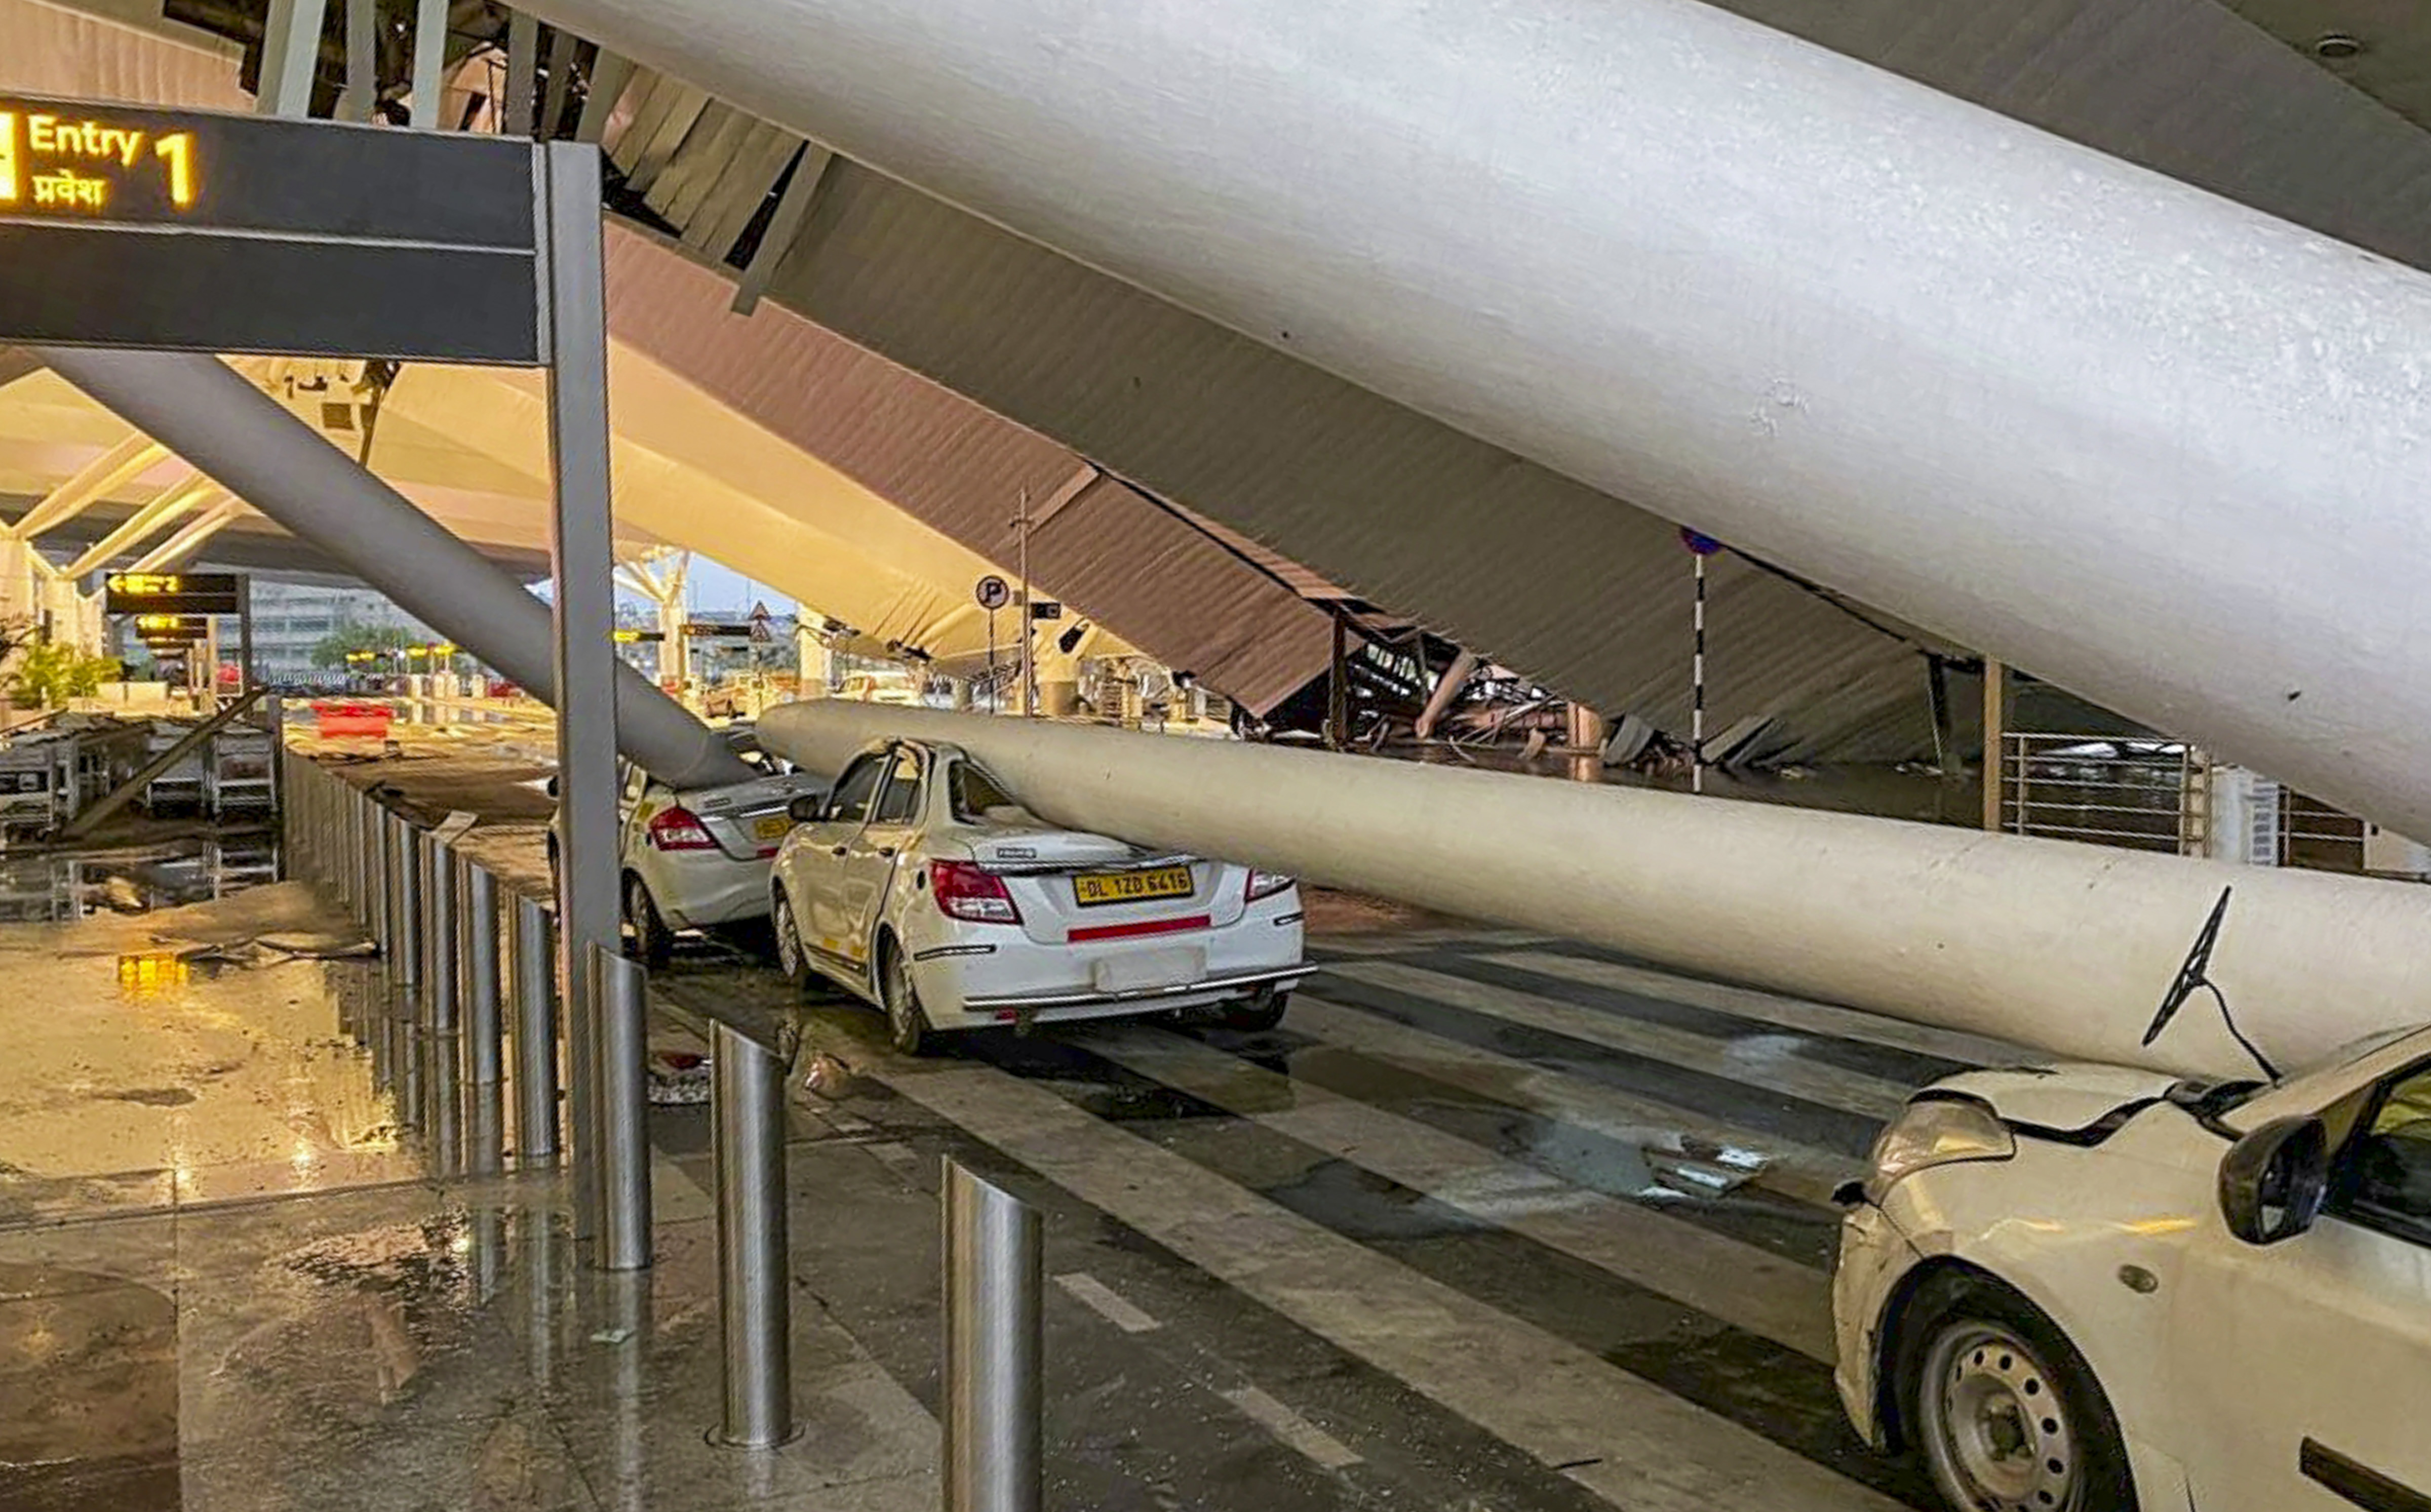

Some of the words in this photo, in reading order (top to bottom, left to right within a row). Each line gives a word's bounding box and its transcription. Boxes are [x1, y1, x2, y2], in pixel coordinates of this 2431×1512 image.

[28, 113, 144, 167] Entry
[155, 131, 192, 206] 1
[32, 168, 106, 207] प्रवेश
[987, 582, 1002, 603] P
[1087, 879, 1110, 898] DL
